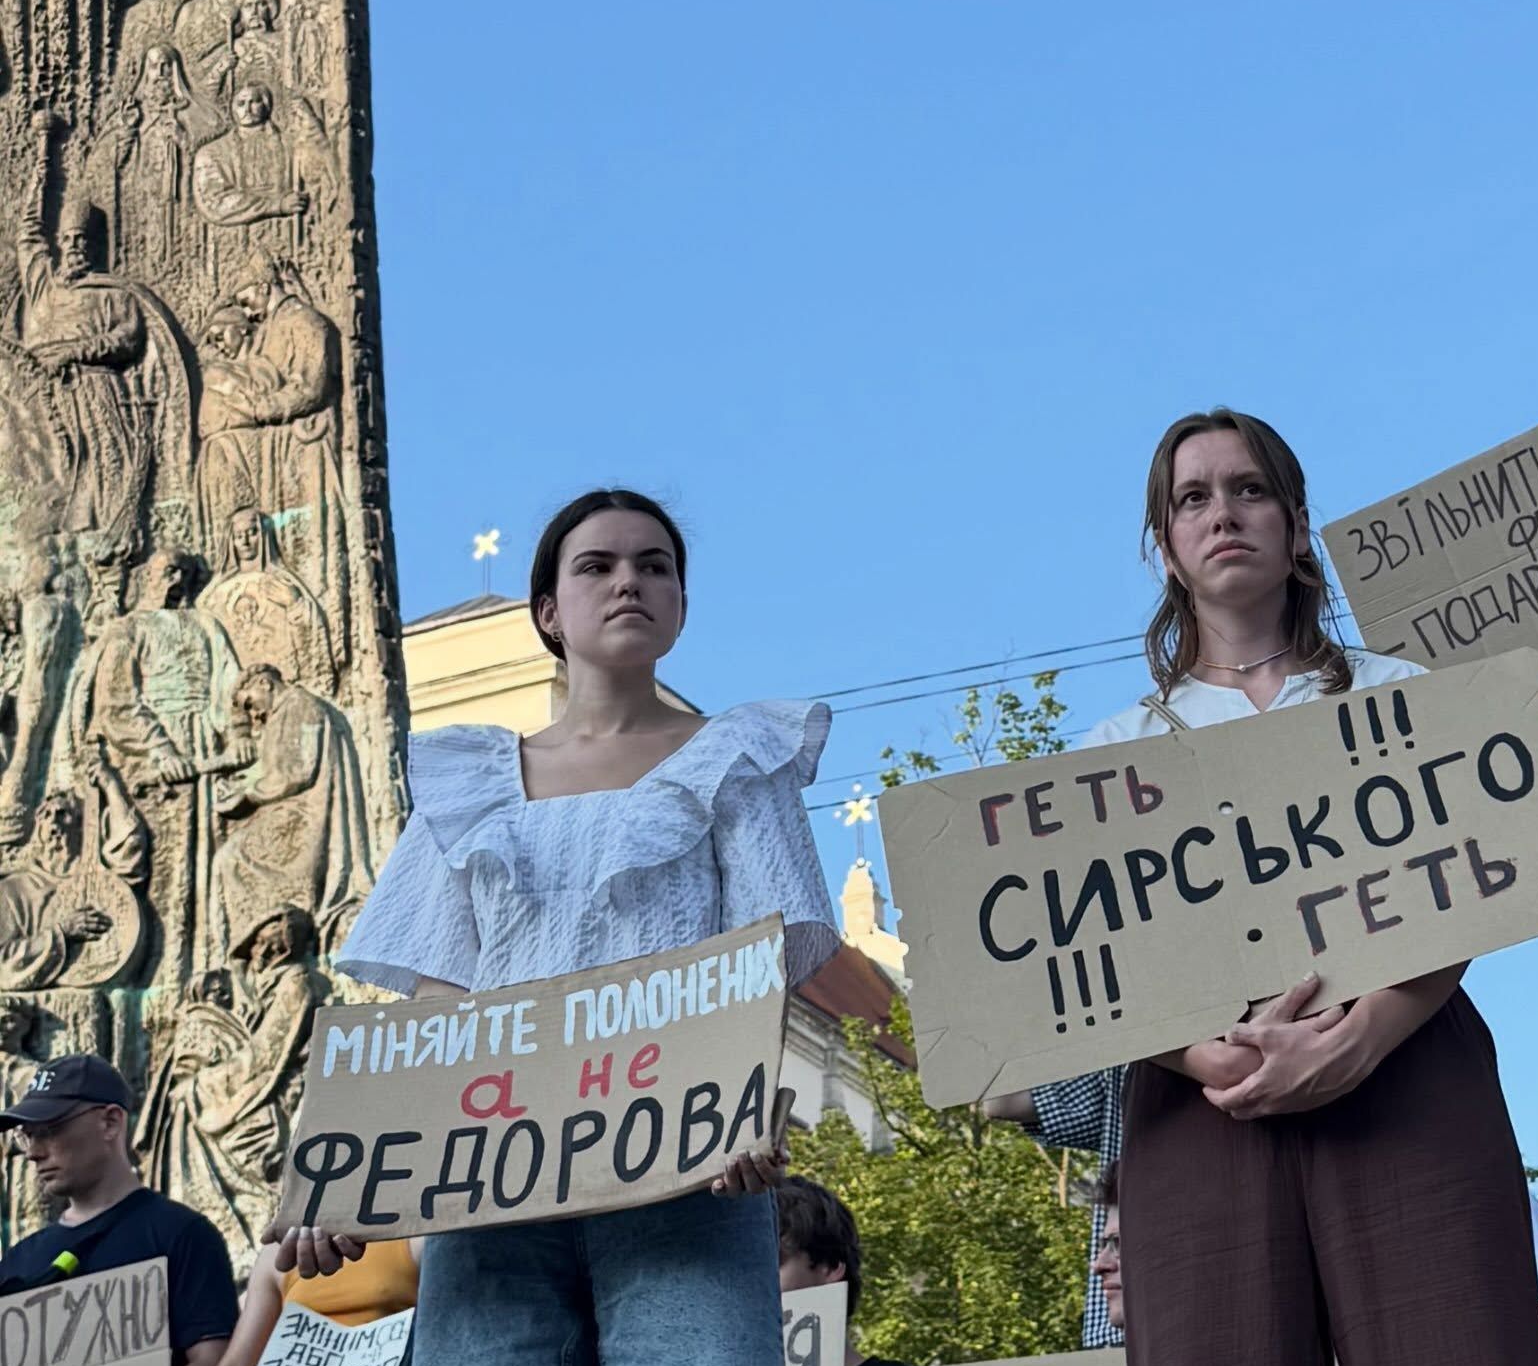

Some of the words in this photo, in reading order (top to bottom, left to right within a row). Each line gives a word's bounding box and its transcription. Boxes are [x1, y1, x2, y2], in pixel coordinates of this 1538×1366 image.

[978, 764, 1164, 847] ГЕТЬ
[1336, 688, 1415, 767] !!!
[978, 731, 1536, 963] СИРСЬКОГО
[563, 932, 786, 1047] ПОЛОНЕНИХ
[1045, 943, 1123, 1035] !!!
[1295, 837, 1519, 957] ГЕТЬ
[293, 1062, 765, 1228] ФЕДОРОВА
